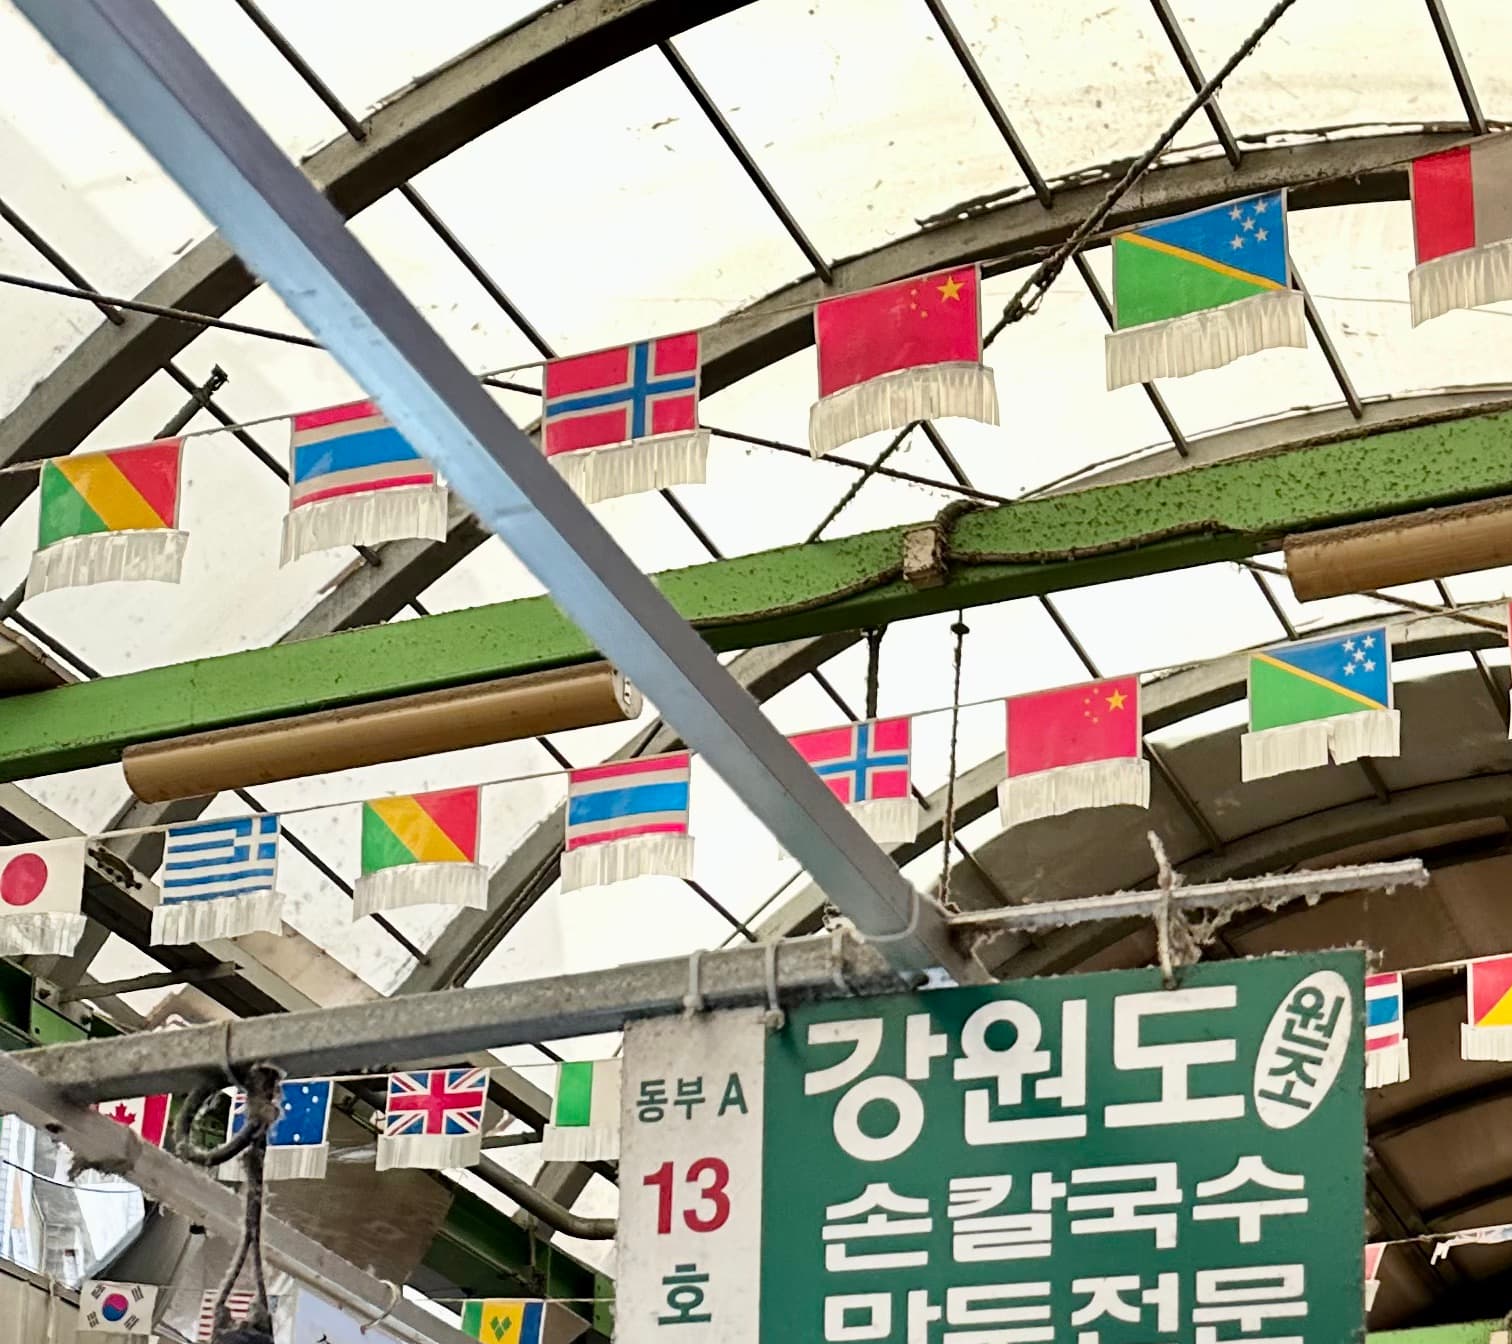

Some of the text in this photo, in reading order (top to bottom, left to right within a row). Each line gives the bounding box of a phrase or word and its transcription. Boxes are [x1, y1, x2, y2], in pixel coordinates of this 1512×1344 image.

[635, 1071, 749, 1124] 동부 A
[803, 984, 1345, 1163] 강원도 원조
[642, 1156, 731, 1235] 13
[821, 1153, 1310, 1273] 손칼국수
[657, 1263, 713, 1326] 호
